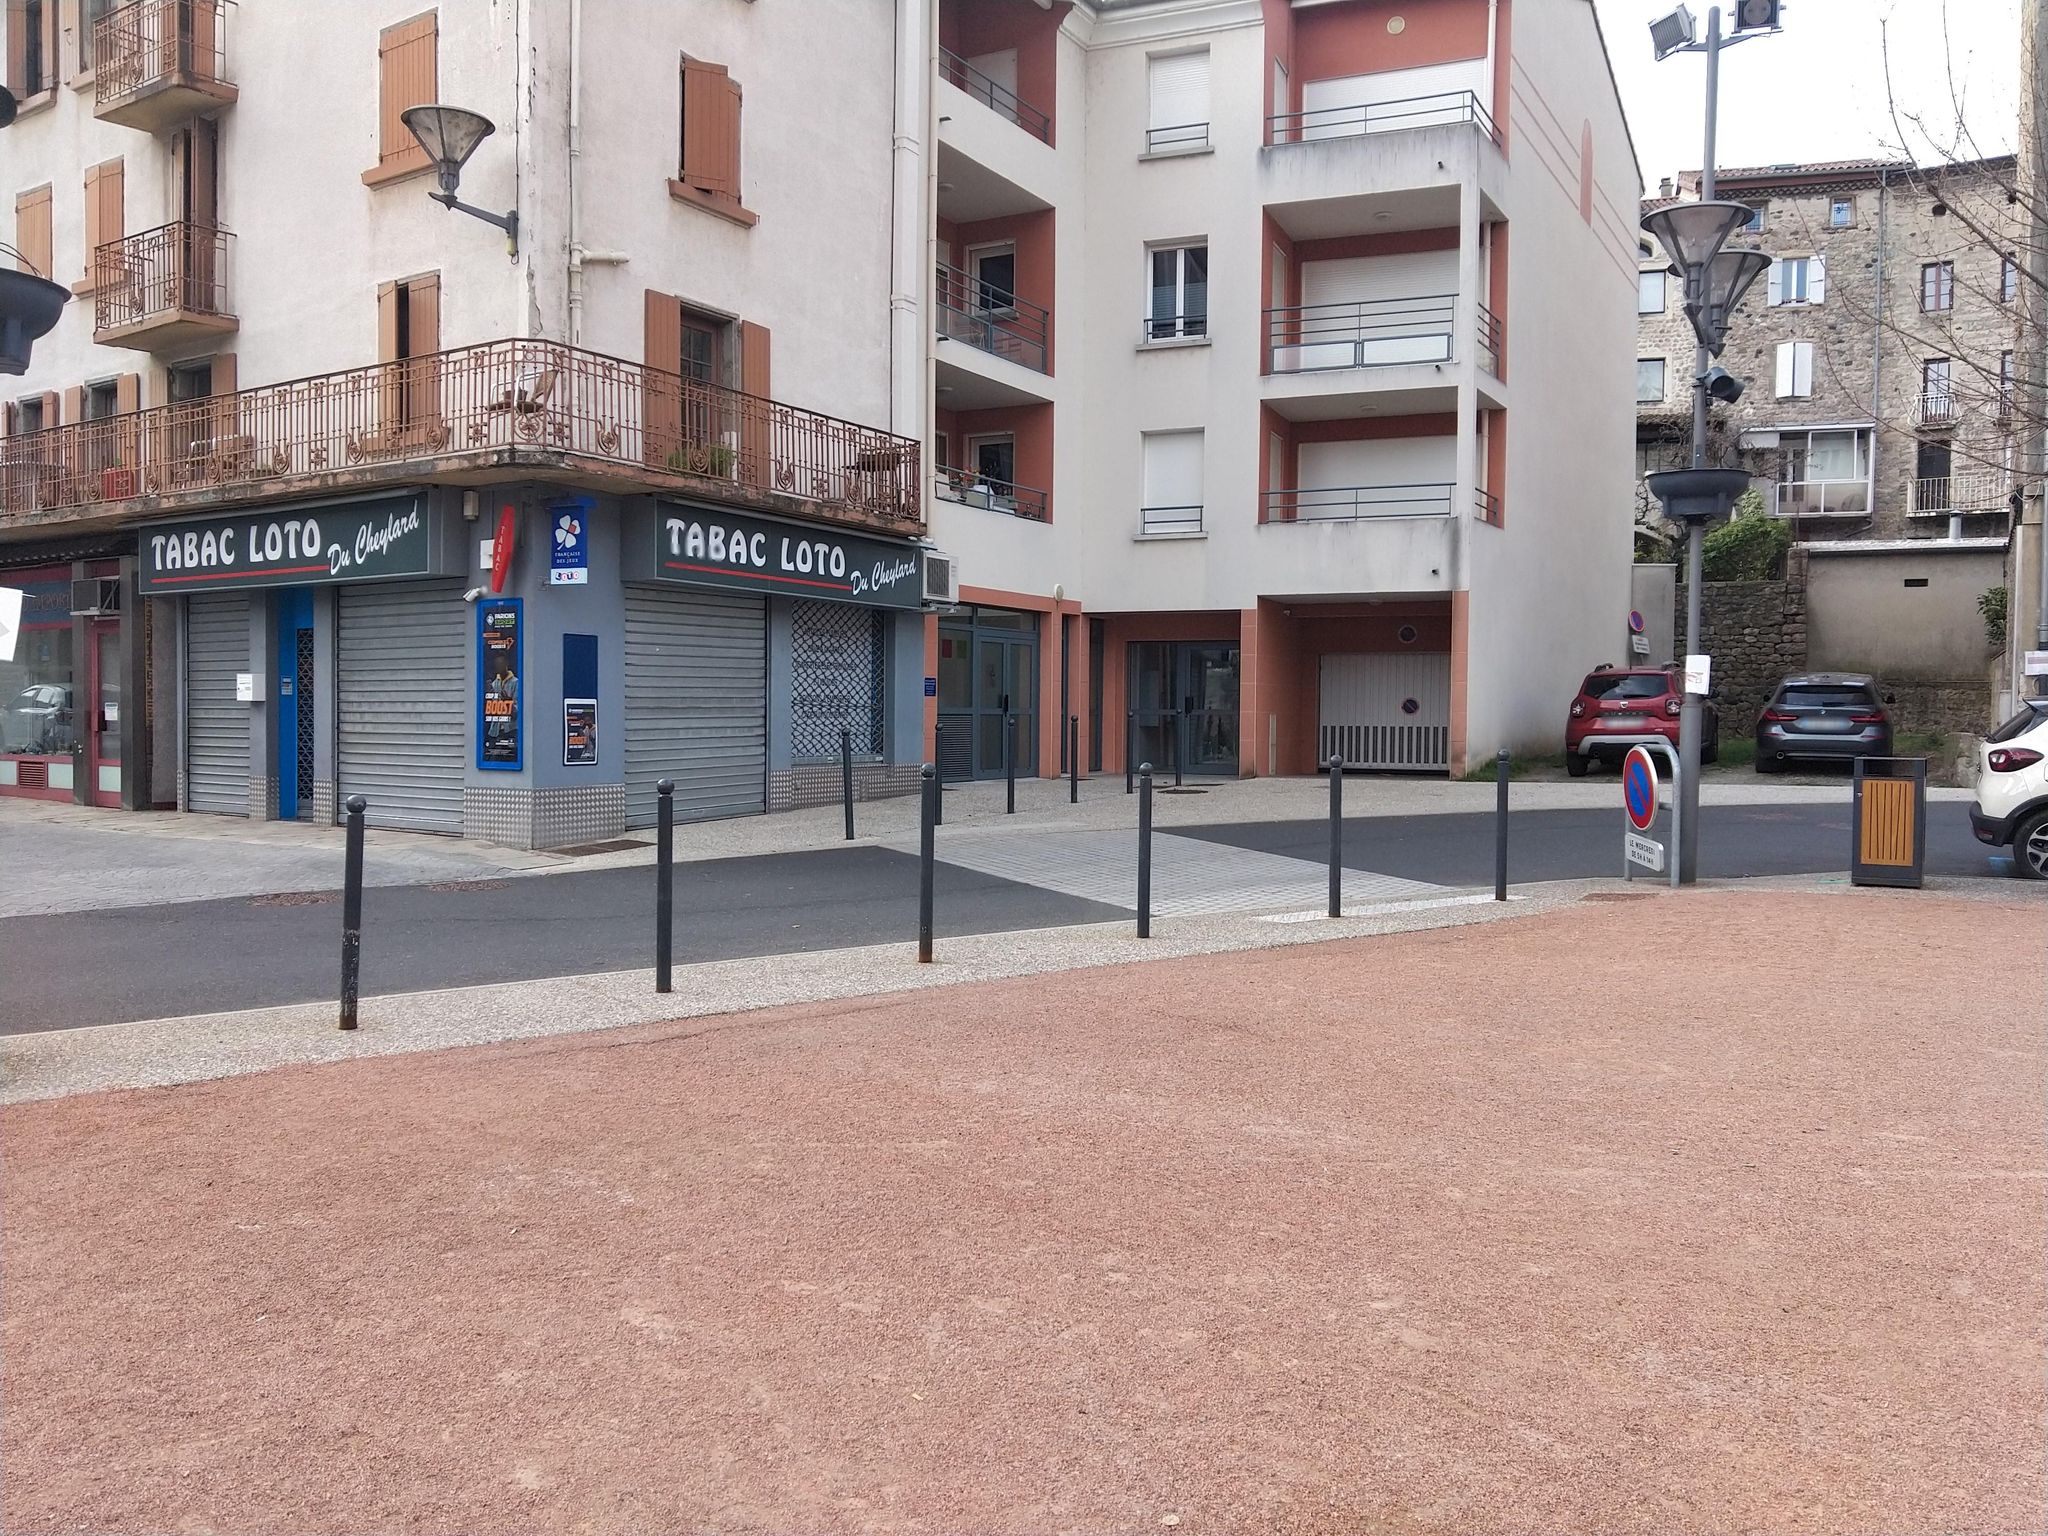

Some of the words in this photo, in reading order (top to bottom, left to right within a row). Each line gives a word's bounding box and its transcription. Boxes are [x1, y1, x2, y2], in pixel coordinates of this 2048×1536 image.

[151, 527, 235, 571] TABAC
[249, 518, 321, 563] LOTO
[327, 543, 350, 576] Du
[355, 499, 419, 565] Cheylard
[494, 525, 505, 572] TABAC
[666, 518, 766, 567] TABAC
[781, 537, 846, 578] LOTO
[851, 570, 869, 596] Du
[872, 553, 917, 592] Cheylard
[555, 571, 580, 581] LOTO
[485, 700, 513, 715] BOOST
